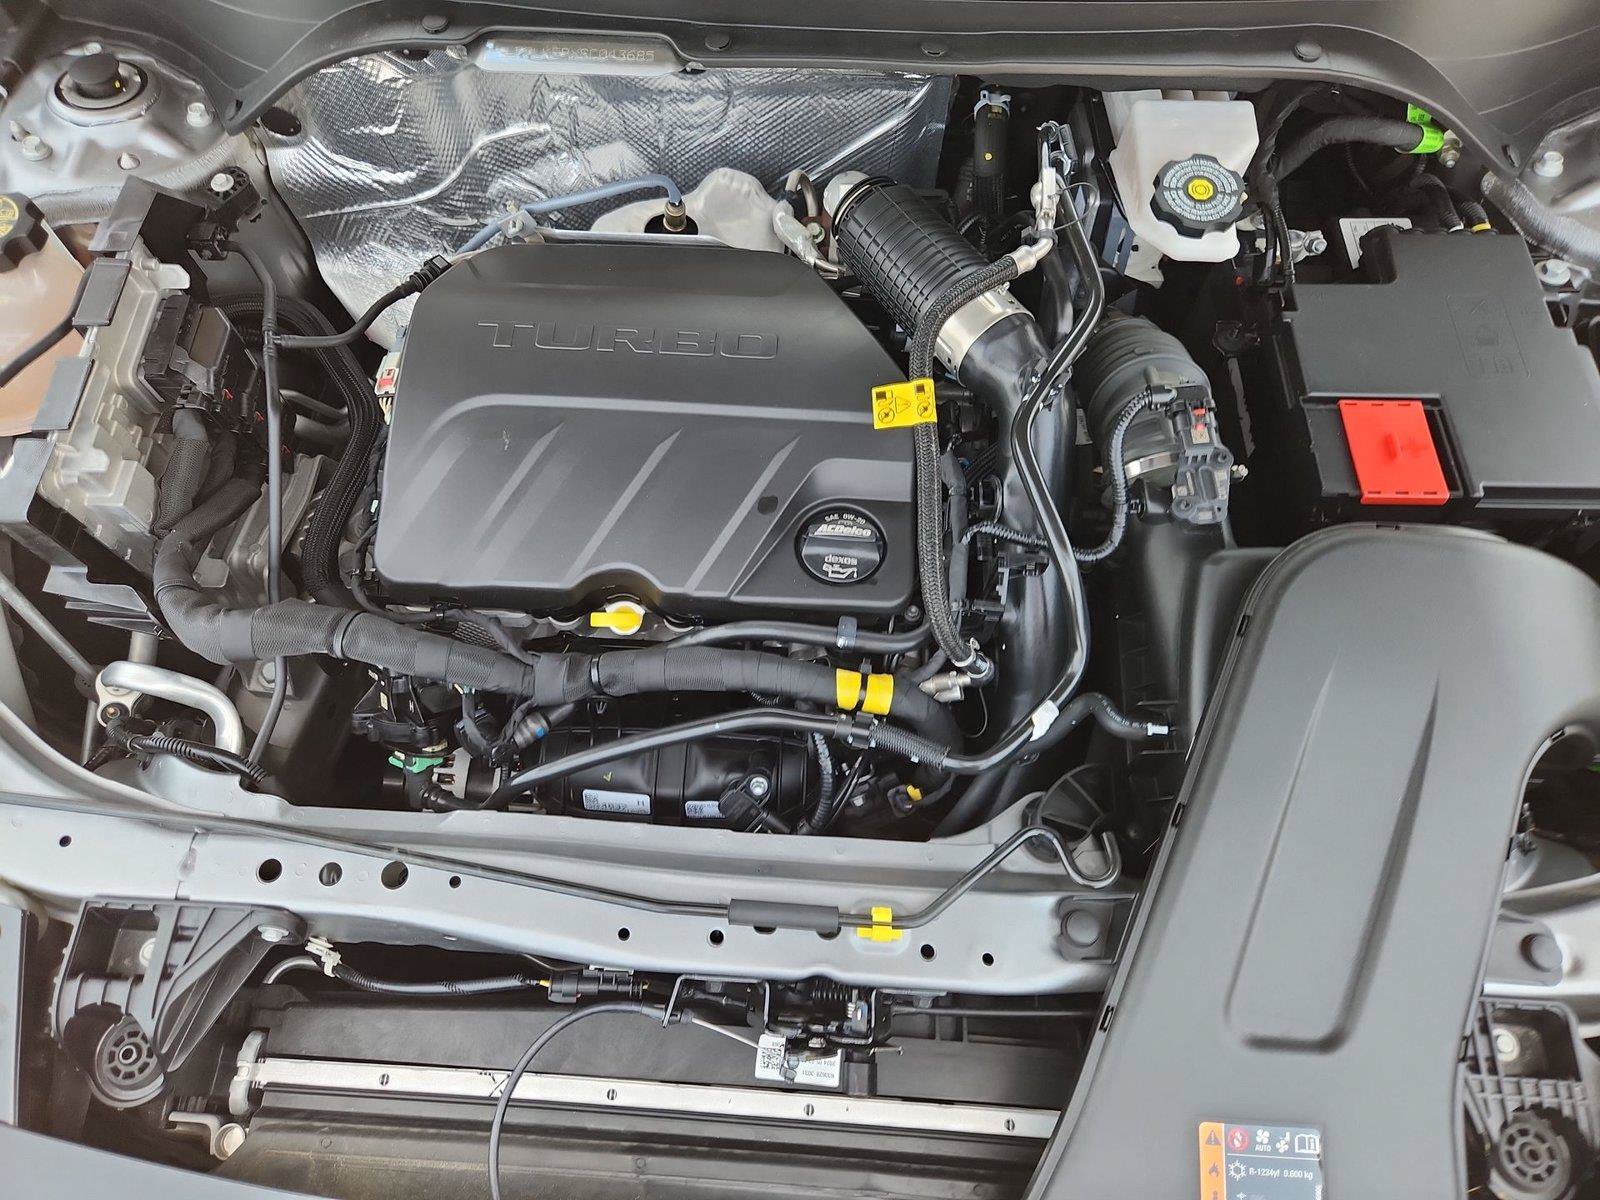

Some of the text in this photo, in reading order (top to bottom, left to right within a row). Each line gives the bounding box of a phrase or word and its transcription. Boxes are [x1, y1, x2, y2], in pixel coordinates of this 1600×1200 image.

[476, 320, 778, 360] TURBO
[824, 513, 840, 523] SAE
[814, 523, 872, 537] ACDelco
[824, 554, 858, 566] dexos
[1254, 1144, 1272, 1153] AUTO
[1303, 1170, 1314, 1181] kg
